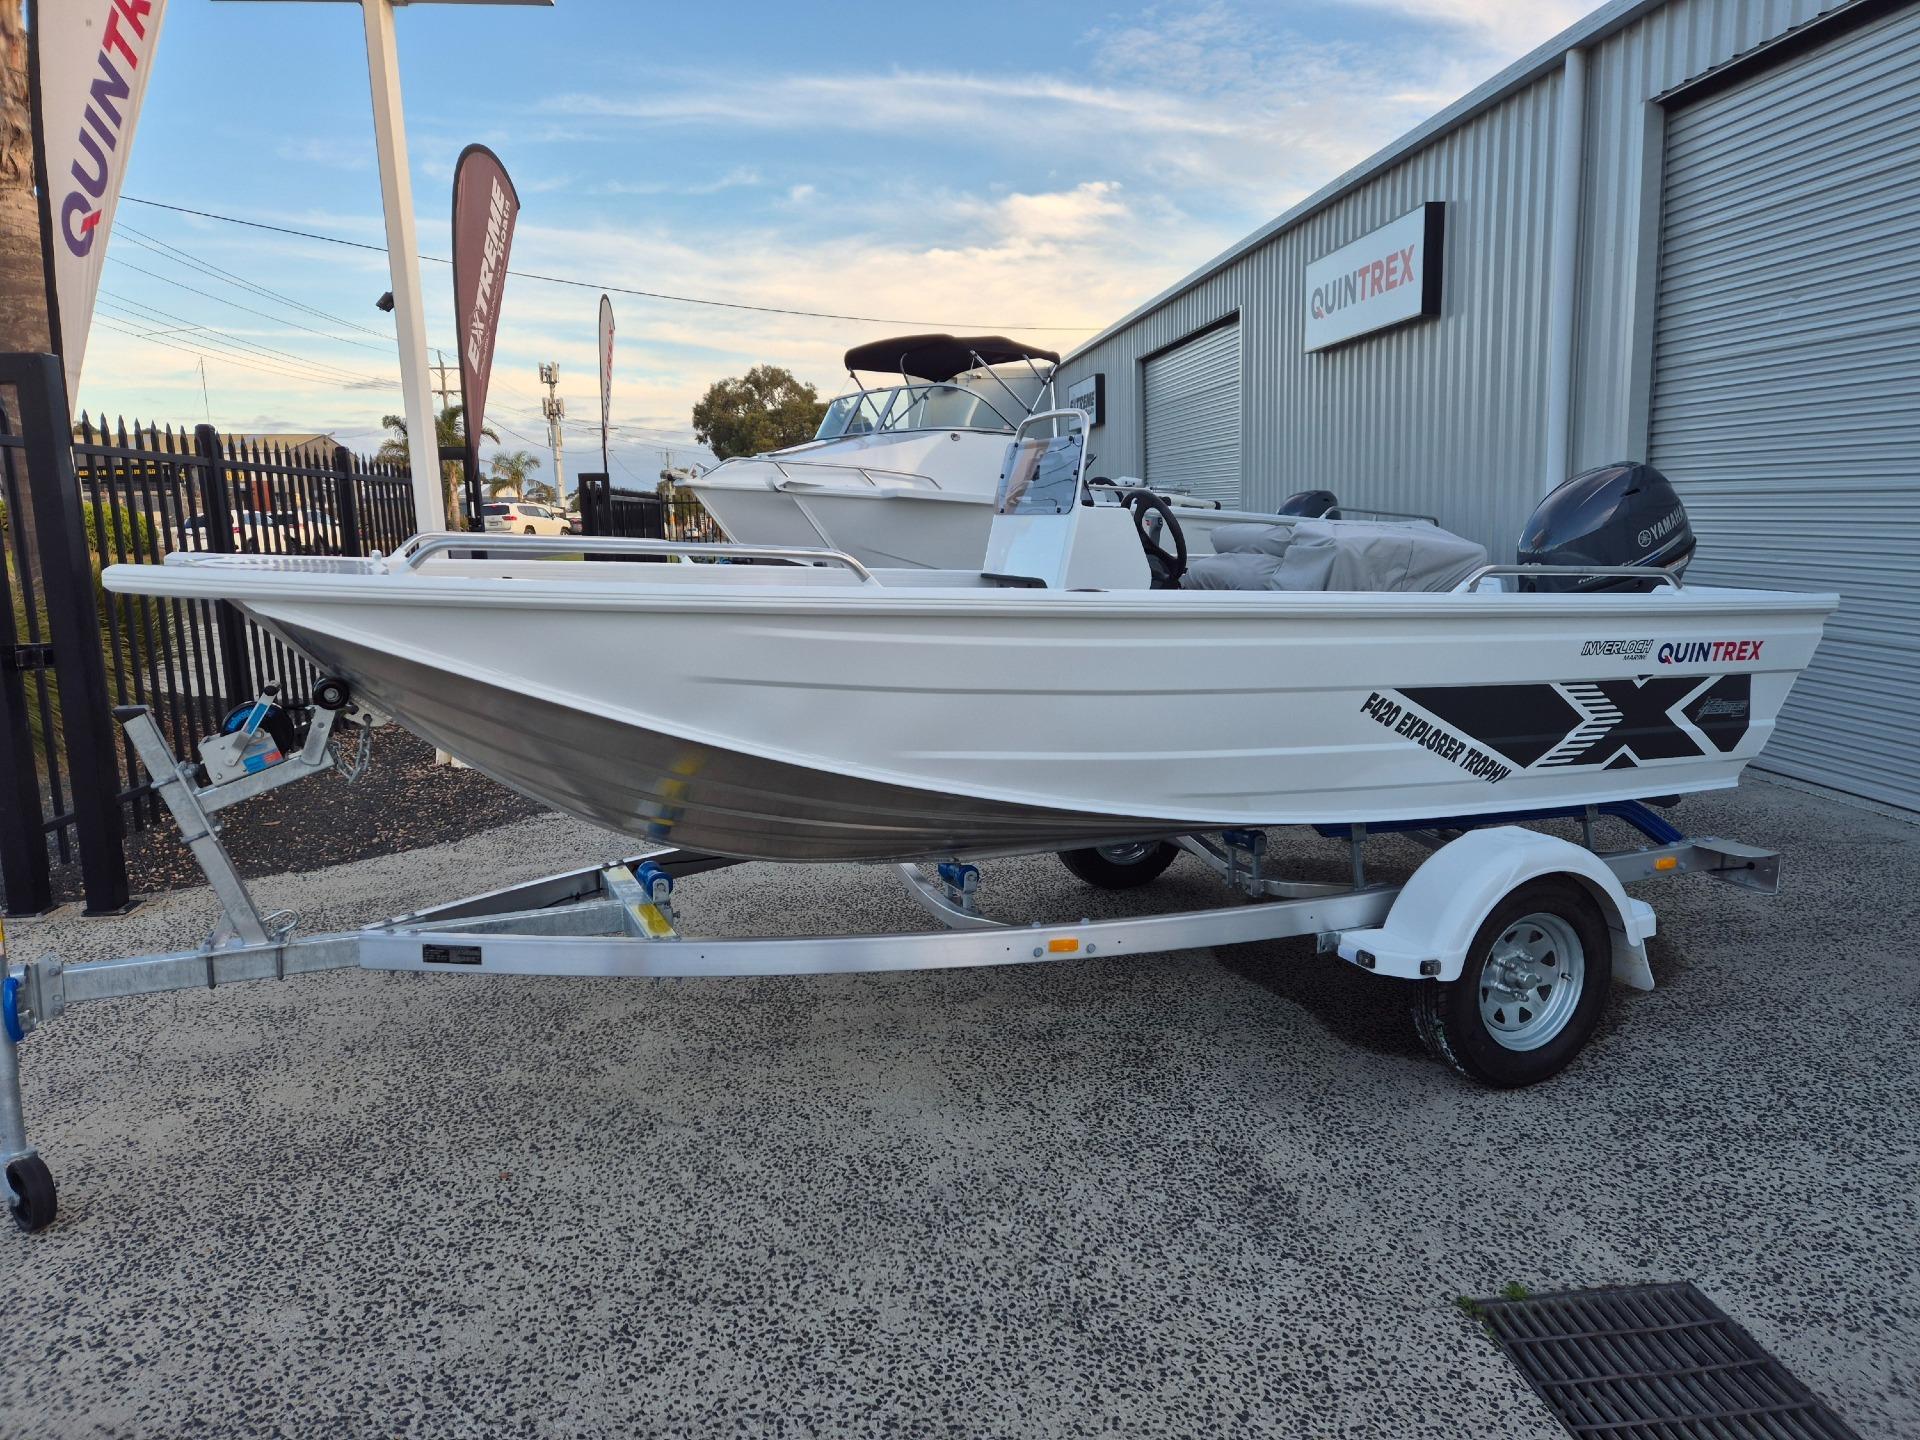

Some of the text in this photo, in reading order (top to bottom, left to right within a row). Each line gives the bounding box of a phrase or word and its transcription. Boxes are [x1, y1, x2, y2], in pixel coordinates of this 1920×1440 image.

[1310, 244, 1415, 321] QUINTREX
[1581, 639, 1654, 656] INVERLOCH
[1623, 653, 1648, 661] MARINE
[1657, 640, 1765, 665] QUINTREX
[1360, 691, 1513, 784] F420 EXPLORER TROPHY
